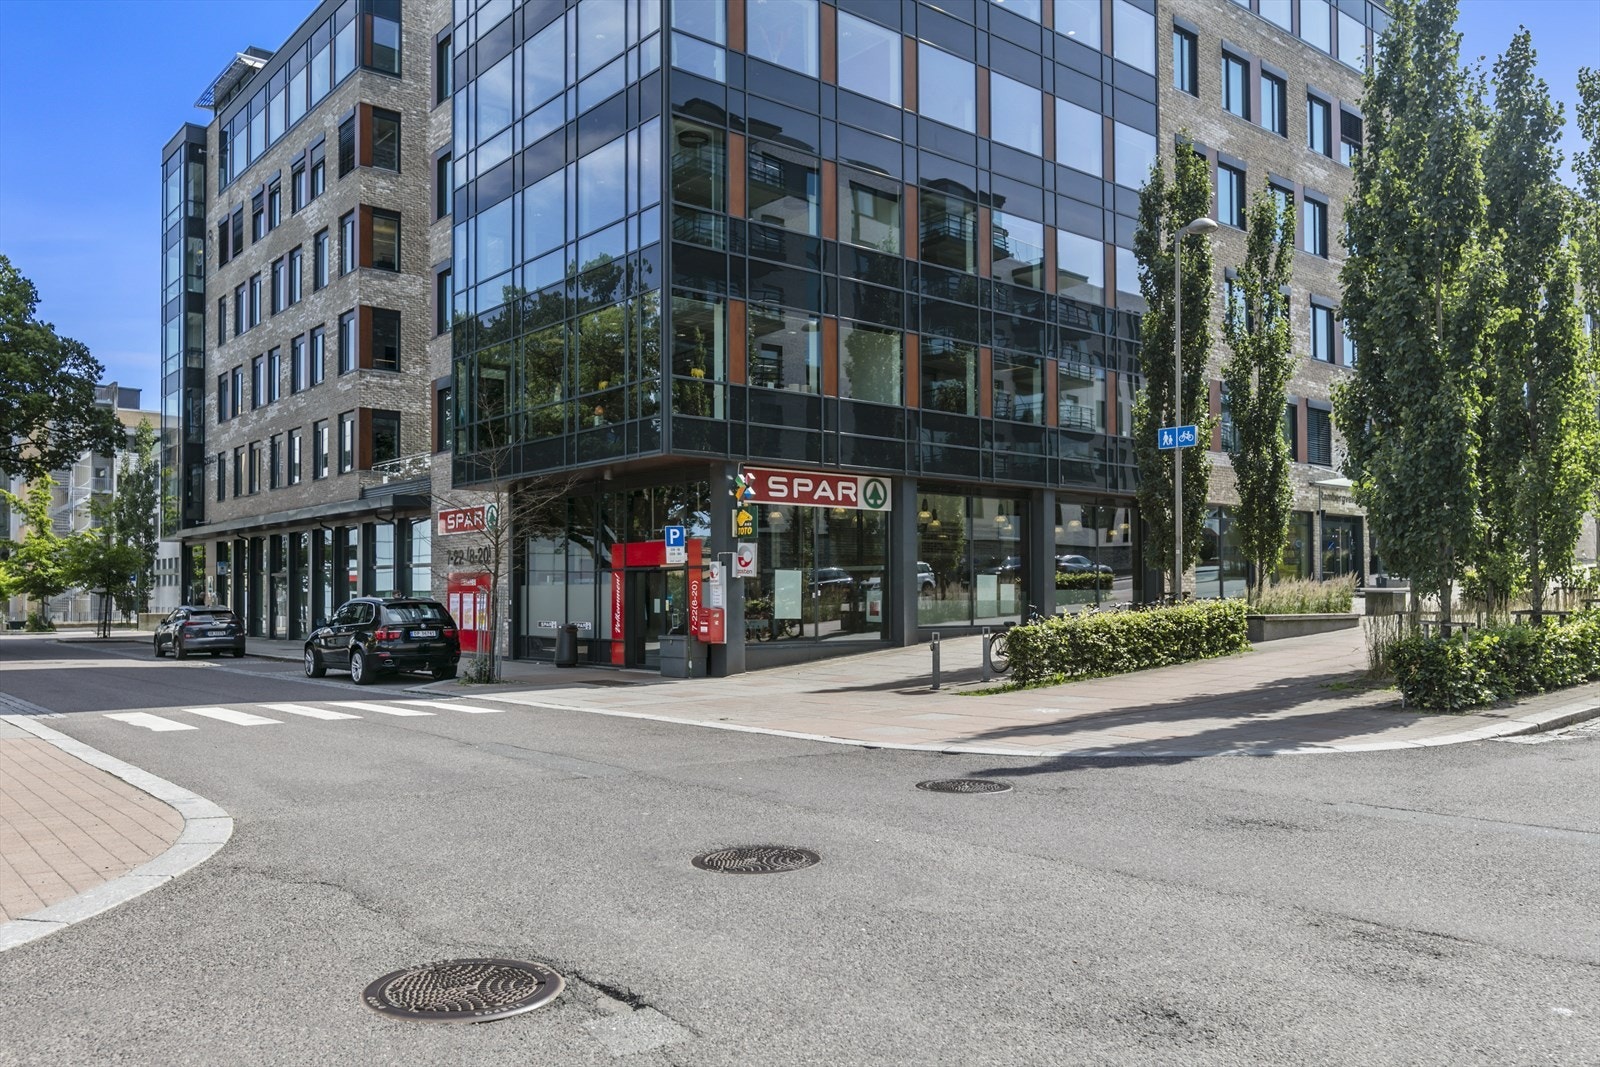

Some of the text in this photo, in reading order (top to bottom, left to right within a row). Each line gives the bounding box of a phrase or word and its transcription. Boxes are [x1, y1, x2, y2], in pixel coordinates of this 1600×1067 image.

[767, 476, 857, 502] SPAR
[447, 511, 483, 530] SPAR
[670, 528, 680, 545] P
